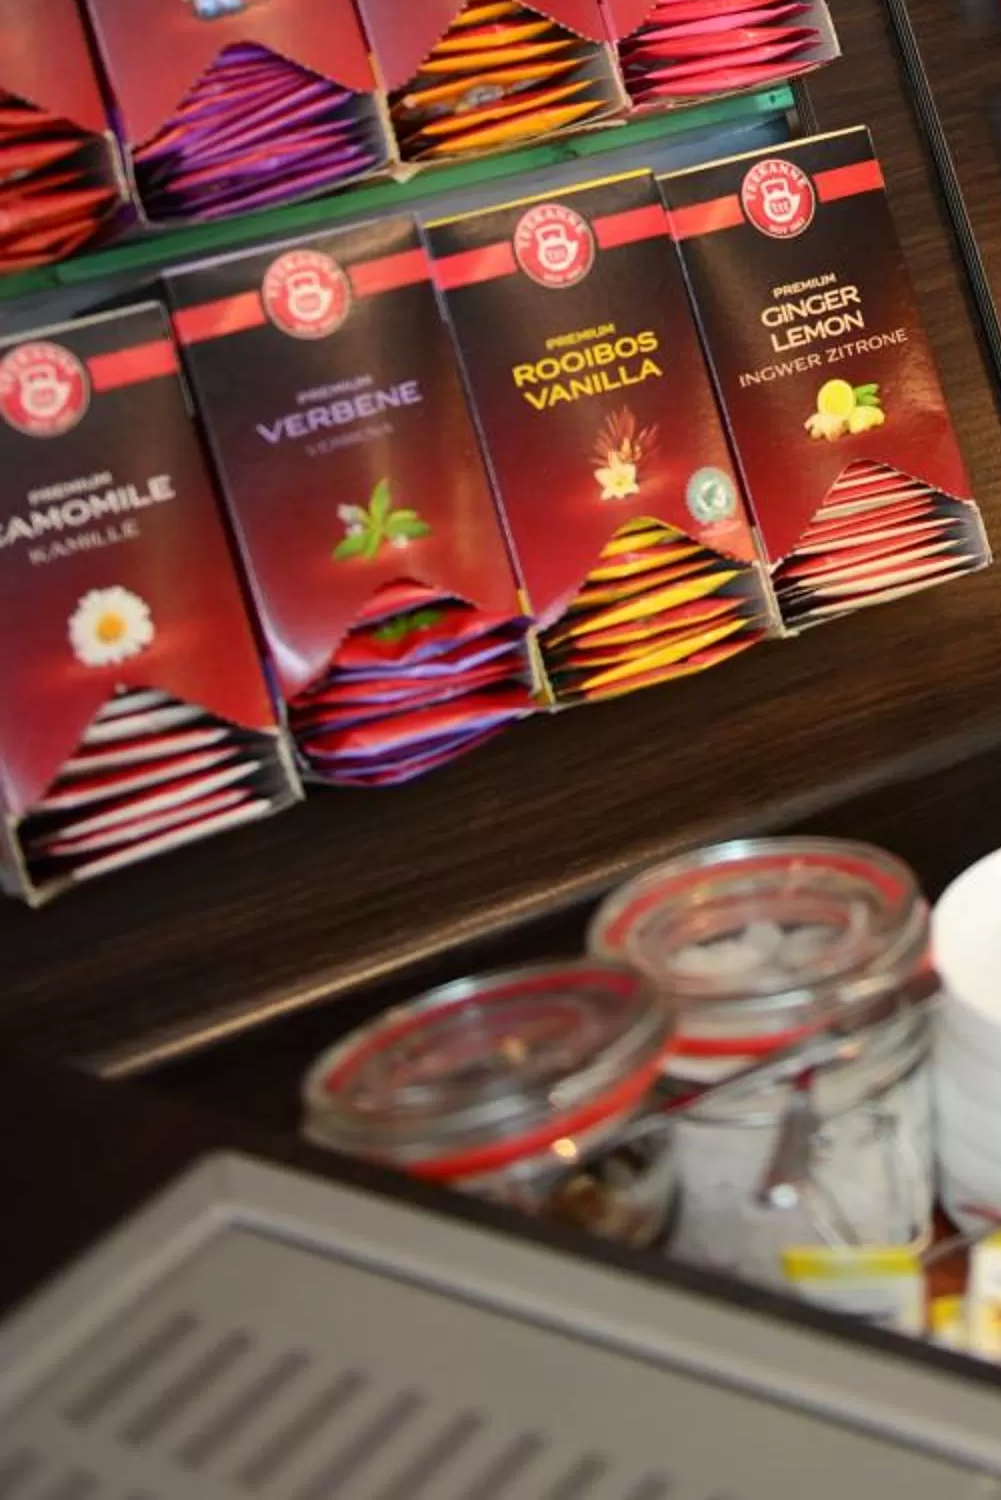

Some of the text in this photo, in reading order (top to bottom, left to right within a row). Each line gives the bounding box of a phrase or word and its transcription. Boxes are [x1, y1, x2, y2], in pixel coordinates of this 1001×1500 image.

[760, 284, 861, 328] GINGER
[773, 272, 837, 299] PREMIUM
[545, 323, 616, 351] PREMIUM
[738, 328, 908, 389] INGWER ZITRONE
[769, 310, 865, 354] LEMON
[512, 330, 660, 389] ROOIBOS
[523, 358, 663, 411] VANILLA
[256, 380, 424, 445] VERBENE
[0, 474, 177, 549] AMOMILE
